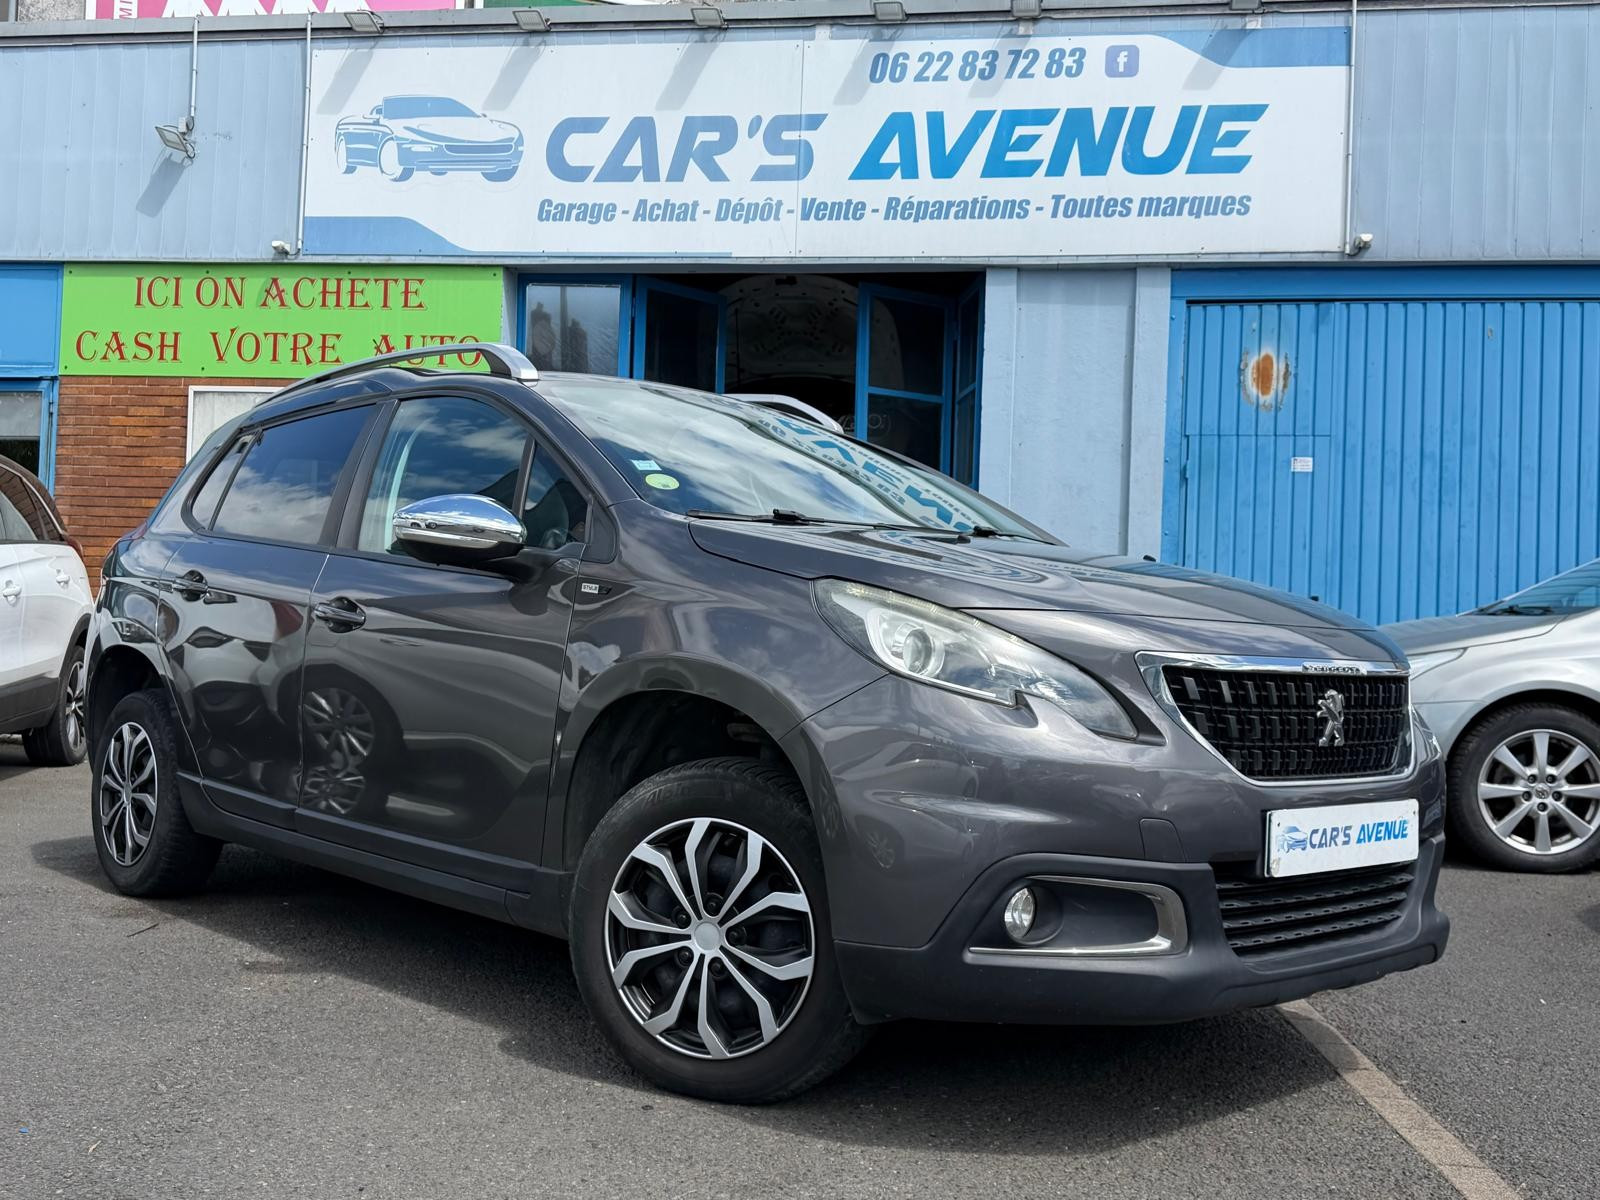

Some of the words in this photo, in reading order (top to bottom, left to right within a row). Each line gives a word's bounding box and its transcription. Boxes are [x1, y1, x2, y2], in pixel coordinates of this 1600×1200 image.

[869, 52, 910, 84] 06
[913, 51, 954, 82] 22
[958, 50, 1000, 81] 83
[1004, 49, 1040, 79] 72
[1044, 47, 1087, 78] 83
[546, 113, 827, 183] CAR'S
[848, 104, 1269, 181] AVENUE
[537, 199, 617, 225] Garage
[633, 199, 699, 222] Achat
[715, 197, 783, 224] Dépôt
[800, 197, 866, 221] Vente
[884, 195, 1030, 223] Réparations
[1051, 194, 1132, 219] Toutes
[1137, 195, 1252, 220] marques
[134, 276, 182, 307] ICI
[195, 276, 247, 308] ON
[260, 276, 427, 310] ACHETE
[75, 330, 182, 363] CASH
[209, 326, 343, 365] VOTRE
[373, 334, 484, 367] AUTO
[1309, 825, 1352, 849] CAR'S
[1356, 819, 1409, 844] AVENUE
